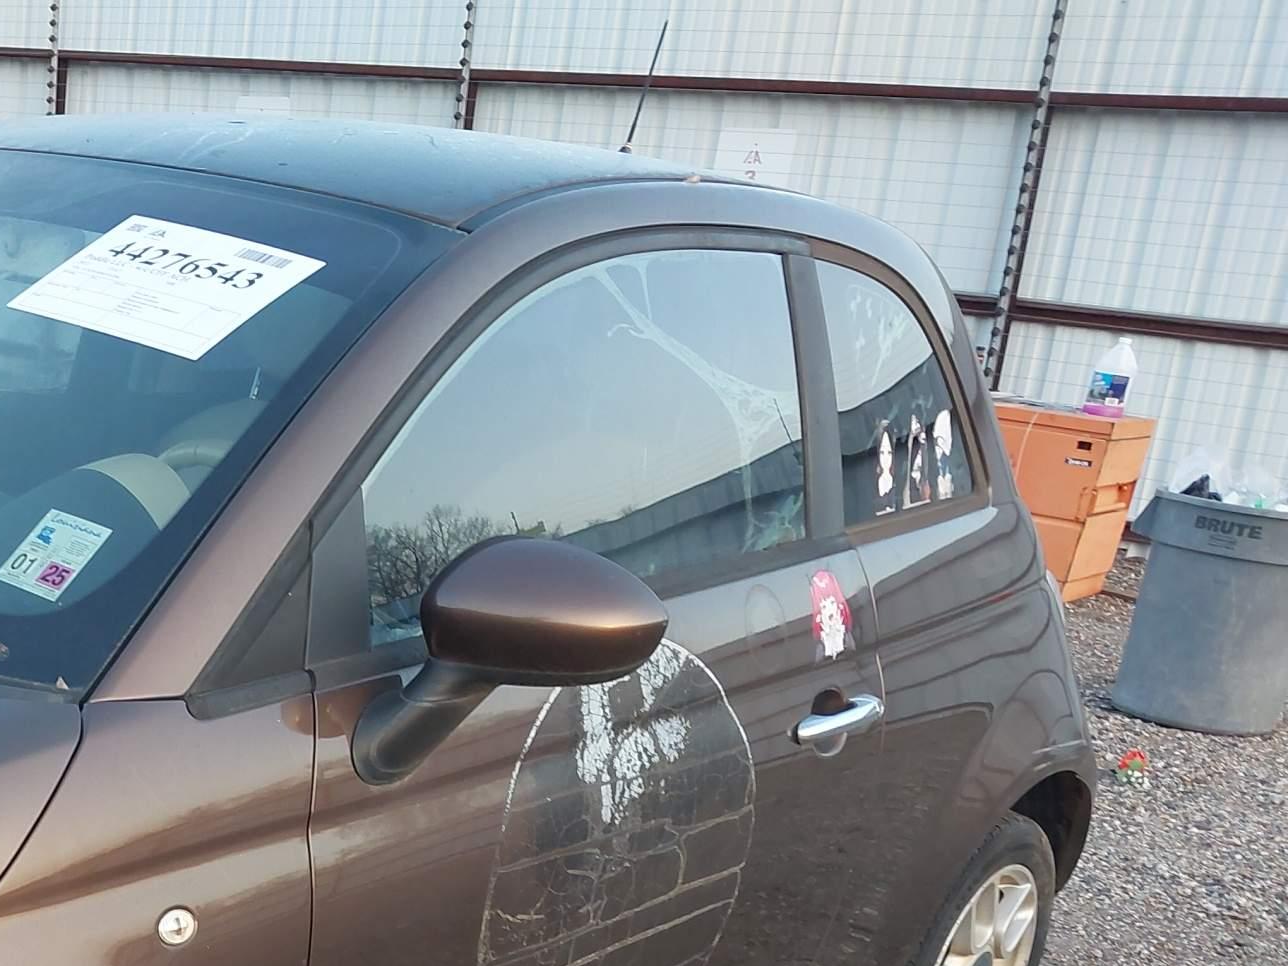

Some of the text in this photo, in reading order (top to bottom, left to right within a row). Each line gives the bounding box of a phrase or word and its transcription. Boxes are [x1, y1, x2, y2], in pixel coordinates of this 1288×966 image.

[108, 241, 265, 289] 44276543
[1194, 515, 1263, 540] BRUTE
[10, 553, 37, 574] 01
[40, 564, 70, 586] 25
